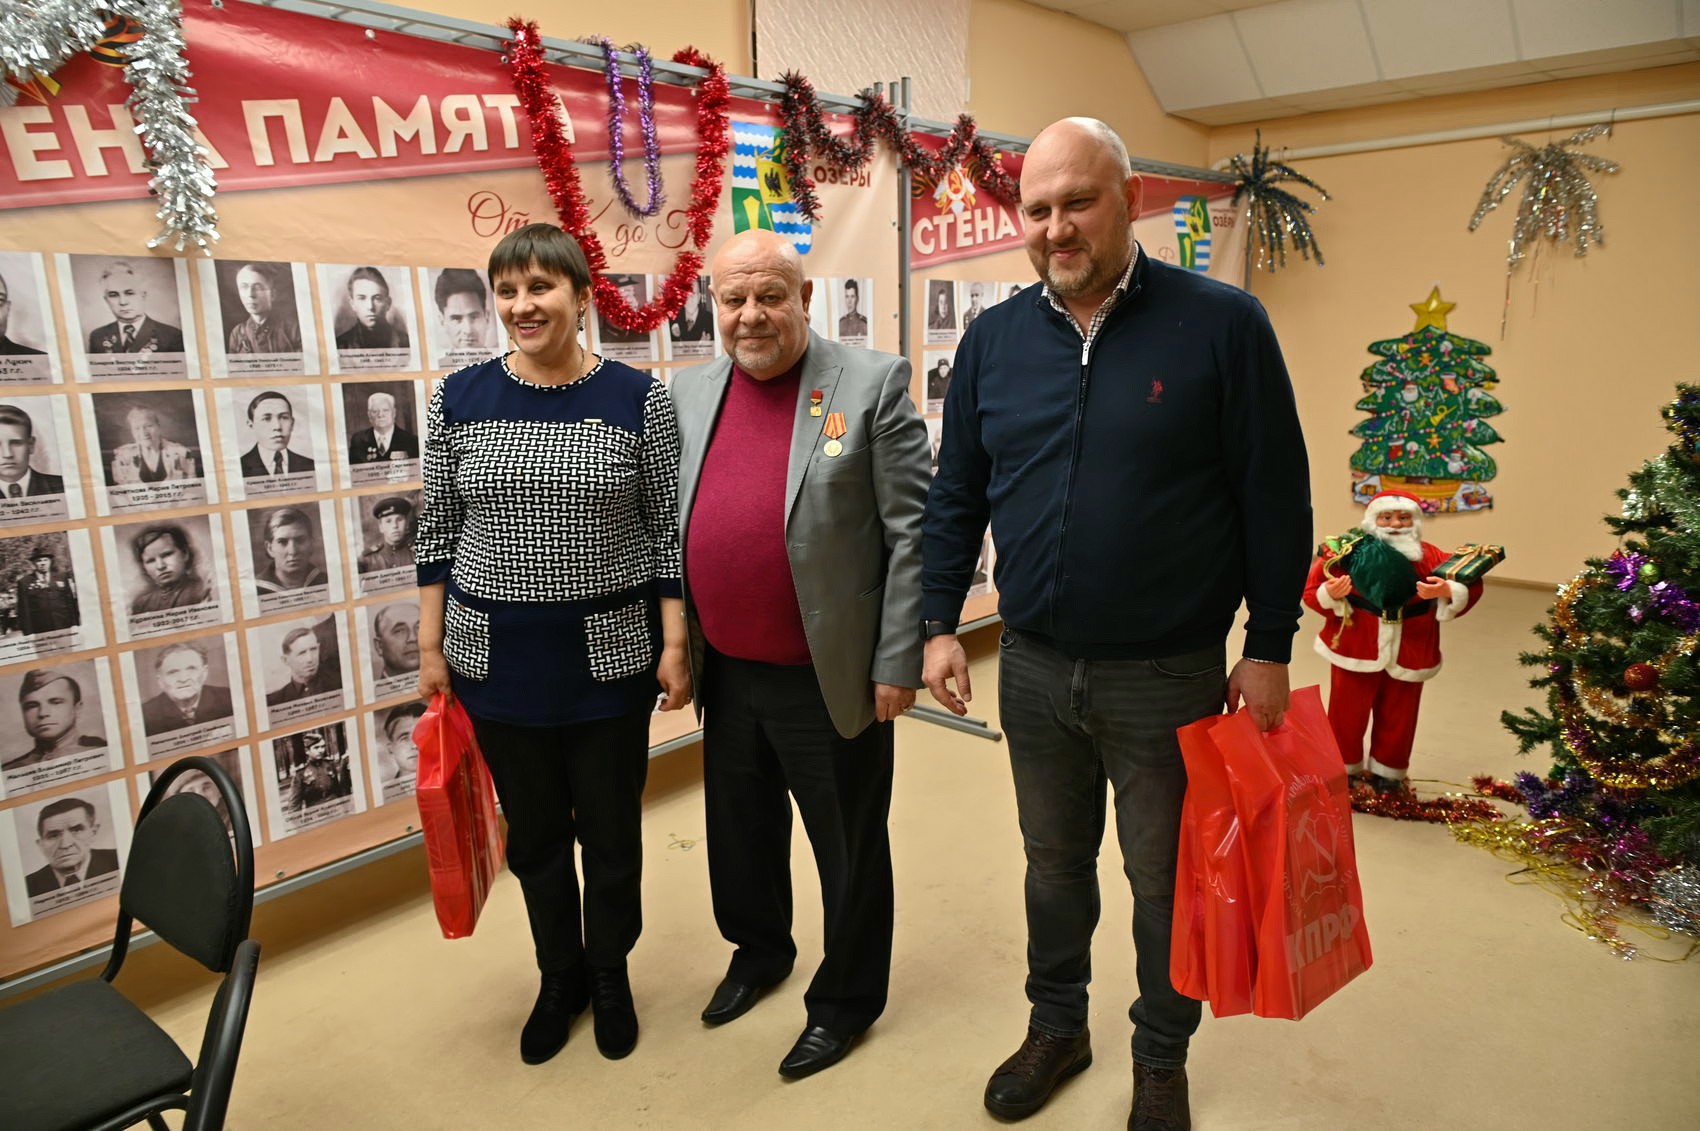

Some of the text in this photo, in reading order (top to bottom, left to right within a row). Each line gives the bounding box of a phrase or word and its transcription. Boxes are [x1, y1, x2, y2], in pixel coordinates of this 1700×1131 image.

[241, 94, 575, 167] ПАМЯТ
[912, 206, 1018, 255] СТЕНА
[1285, 902, 1361, 973] КПРФ
